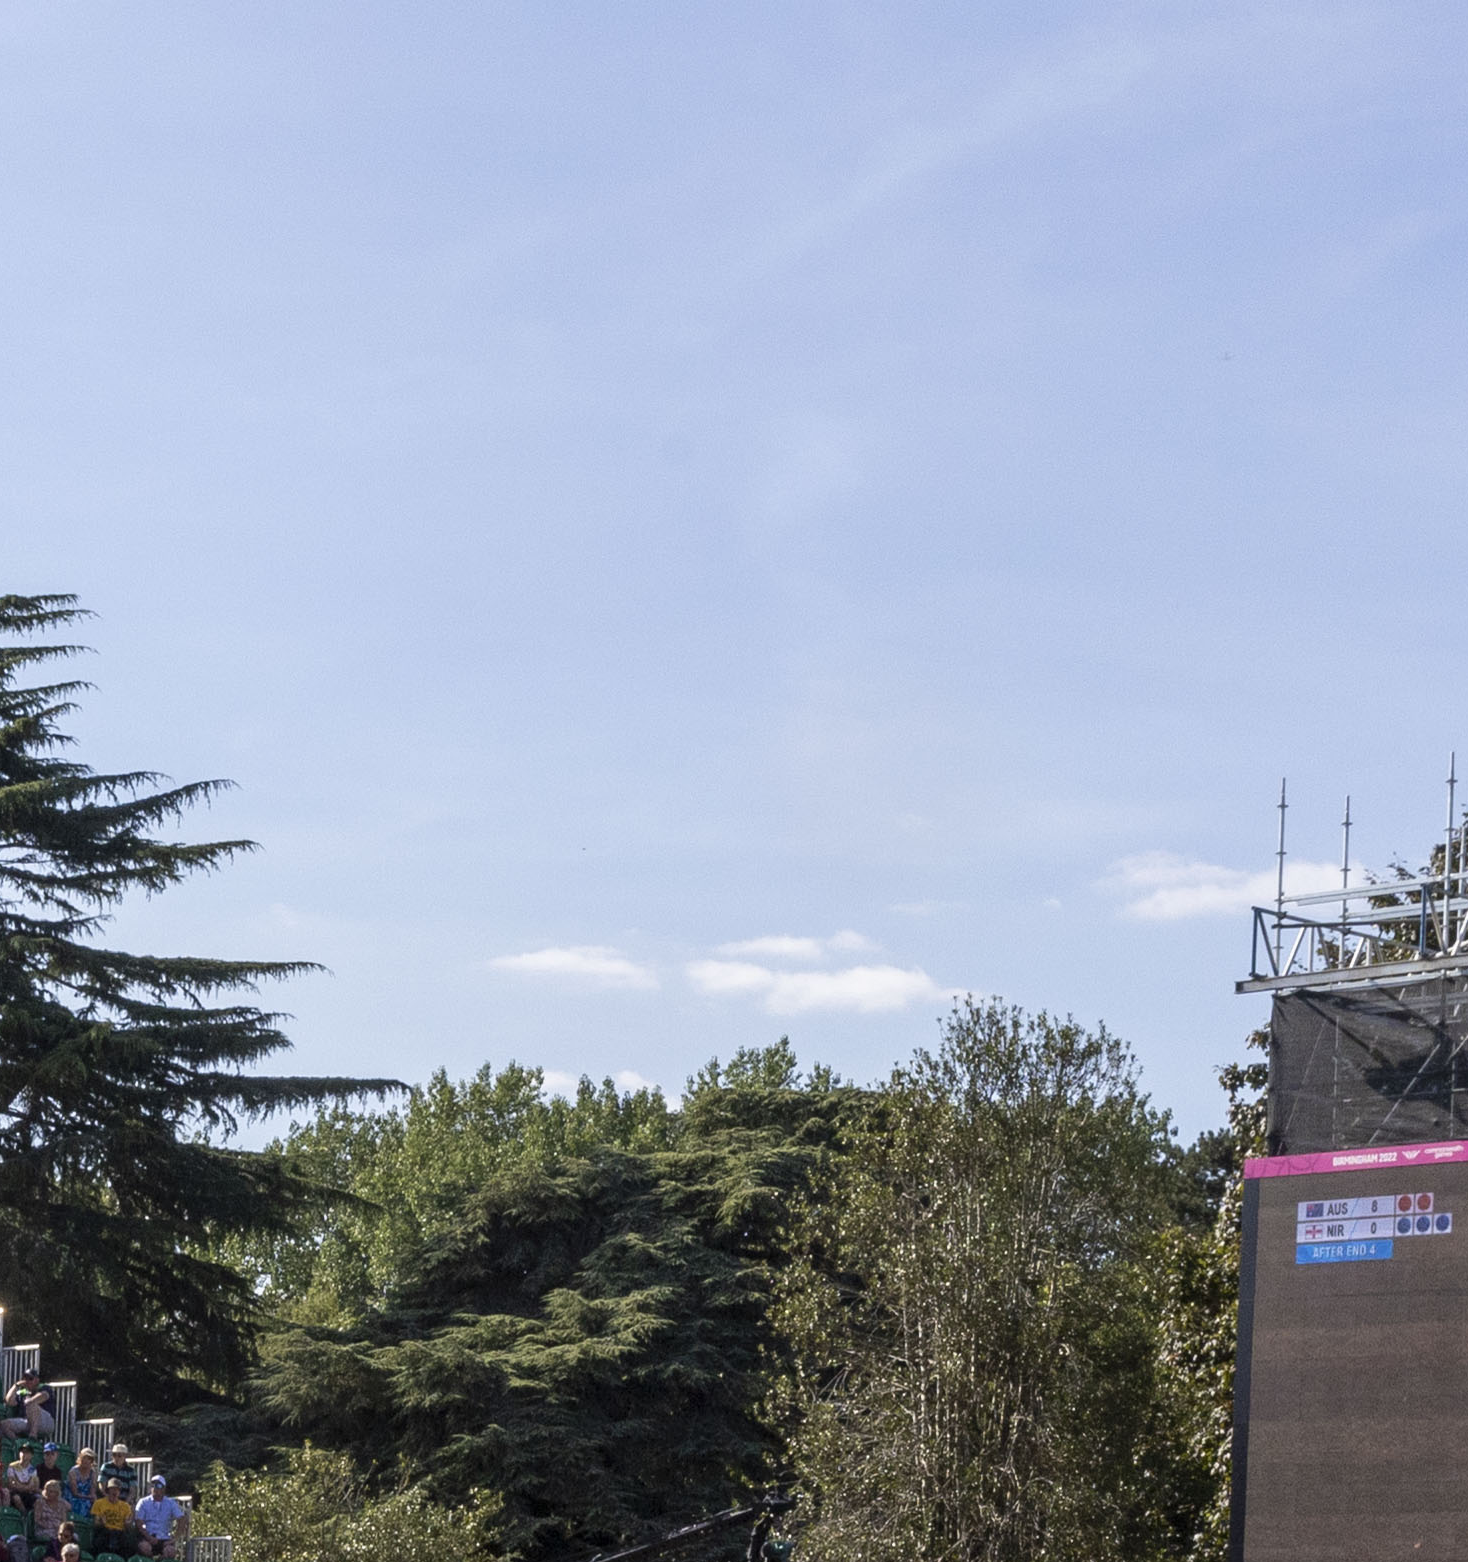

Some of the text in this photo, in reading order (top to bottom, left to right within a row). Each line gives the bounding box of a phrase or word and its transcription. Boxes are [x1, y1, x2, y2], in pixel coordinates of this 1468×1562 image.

[1327, 1200, 1378, 1216] AUS 8
[1327, 1222, 1377, 1238] NIR 0
[1313, 1244, 1376, 1258] AFTER END 4
